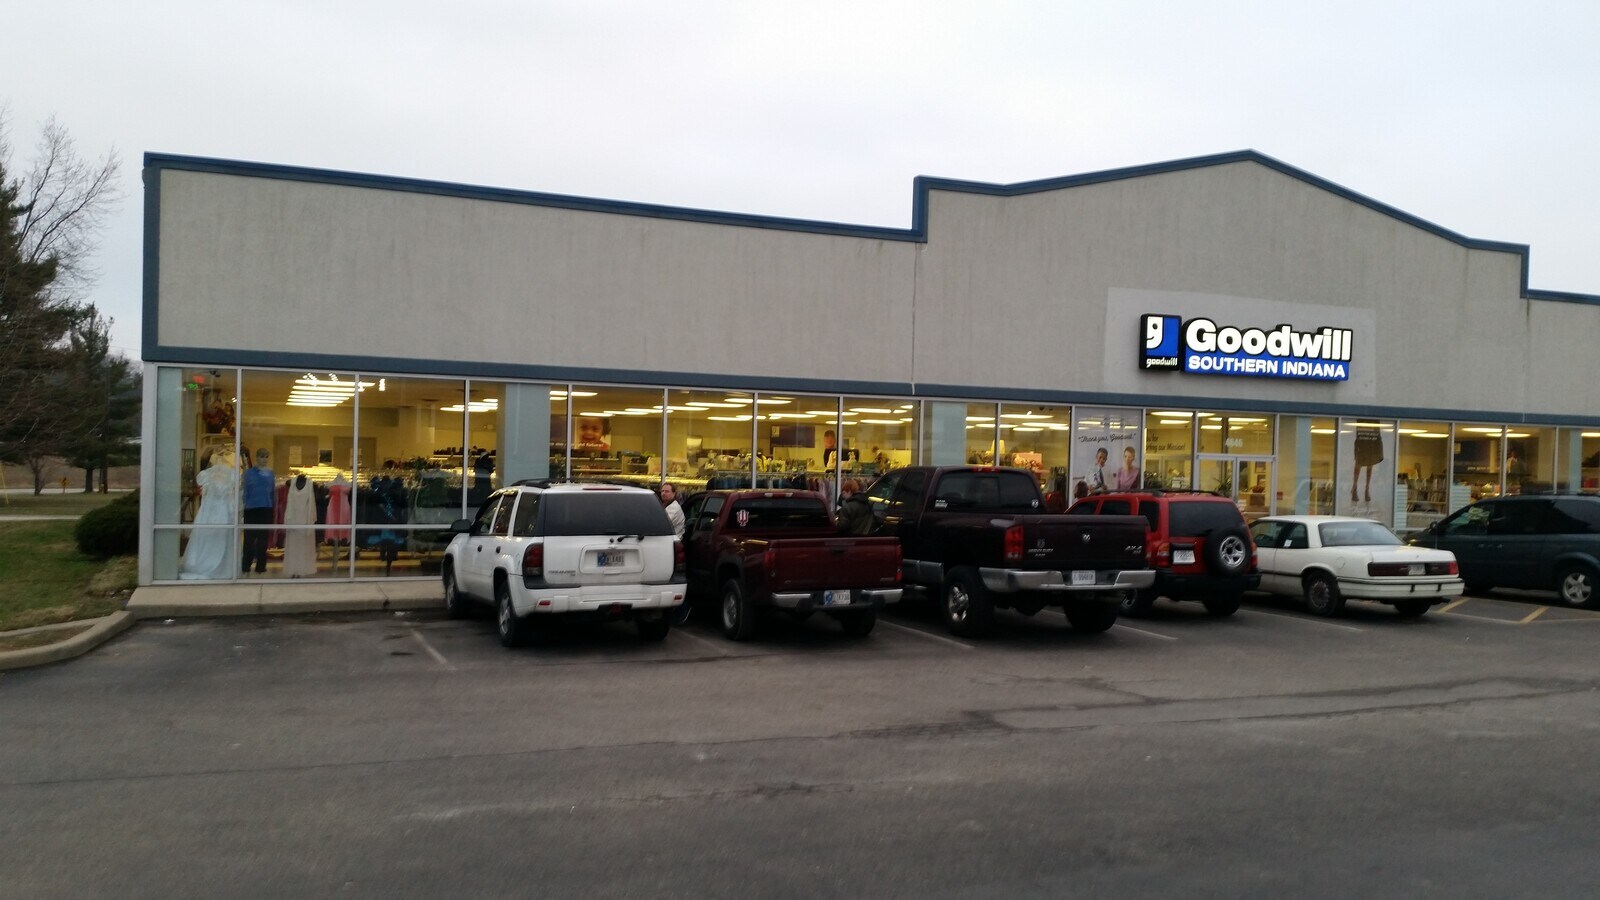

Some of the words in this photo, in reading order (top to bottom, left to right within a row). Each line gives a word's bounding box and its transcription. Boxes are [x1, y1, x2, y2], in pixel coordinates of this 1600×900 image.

[1186, 318, 1352, 361] Goodwill
[1146, 357, 1178, 368] goodwill
[1188, 355, 1278, 374] SOUTHERN
[1282, 362, 1346, 378] INDIANA
